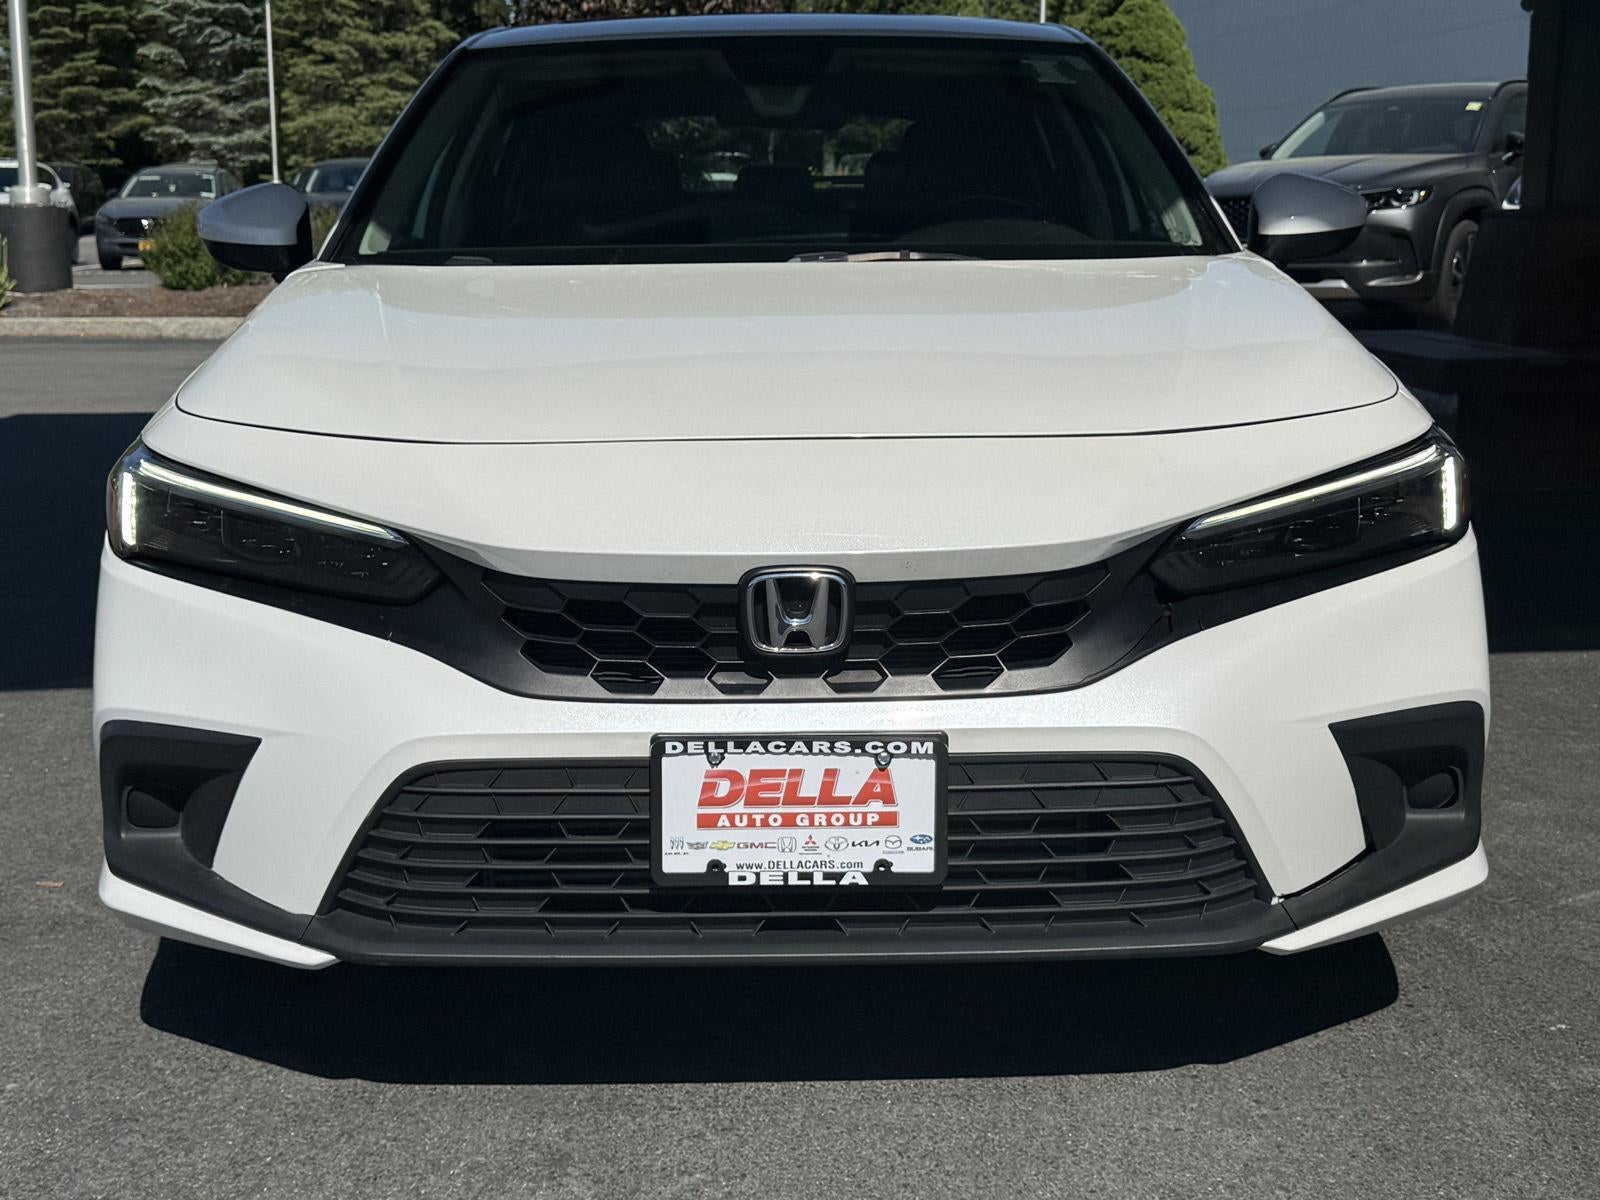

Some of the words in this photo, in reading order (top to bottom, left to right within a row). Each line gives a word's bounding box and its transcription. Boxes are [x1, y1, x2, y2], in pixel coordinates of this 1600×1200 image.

[664, 741, 934, 755] DELLACARS.COM
[697, 767, 898, 808] DELLA
[717, 813, 783, 827] AUTO
[796, 812, 880, 826] GROUP
[737, 841, 776, 849] GMC
[736, 860, 864, 870] www.DELLACARS.com
[728, 870, 869, 886] DELLA
